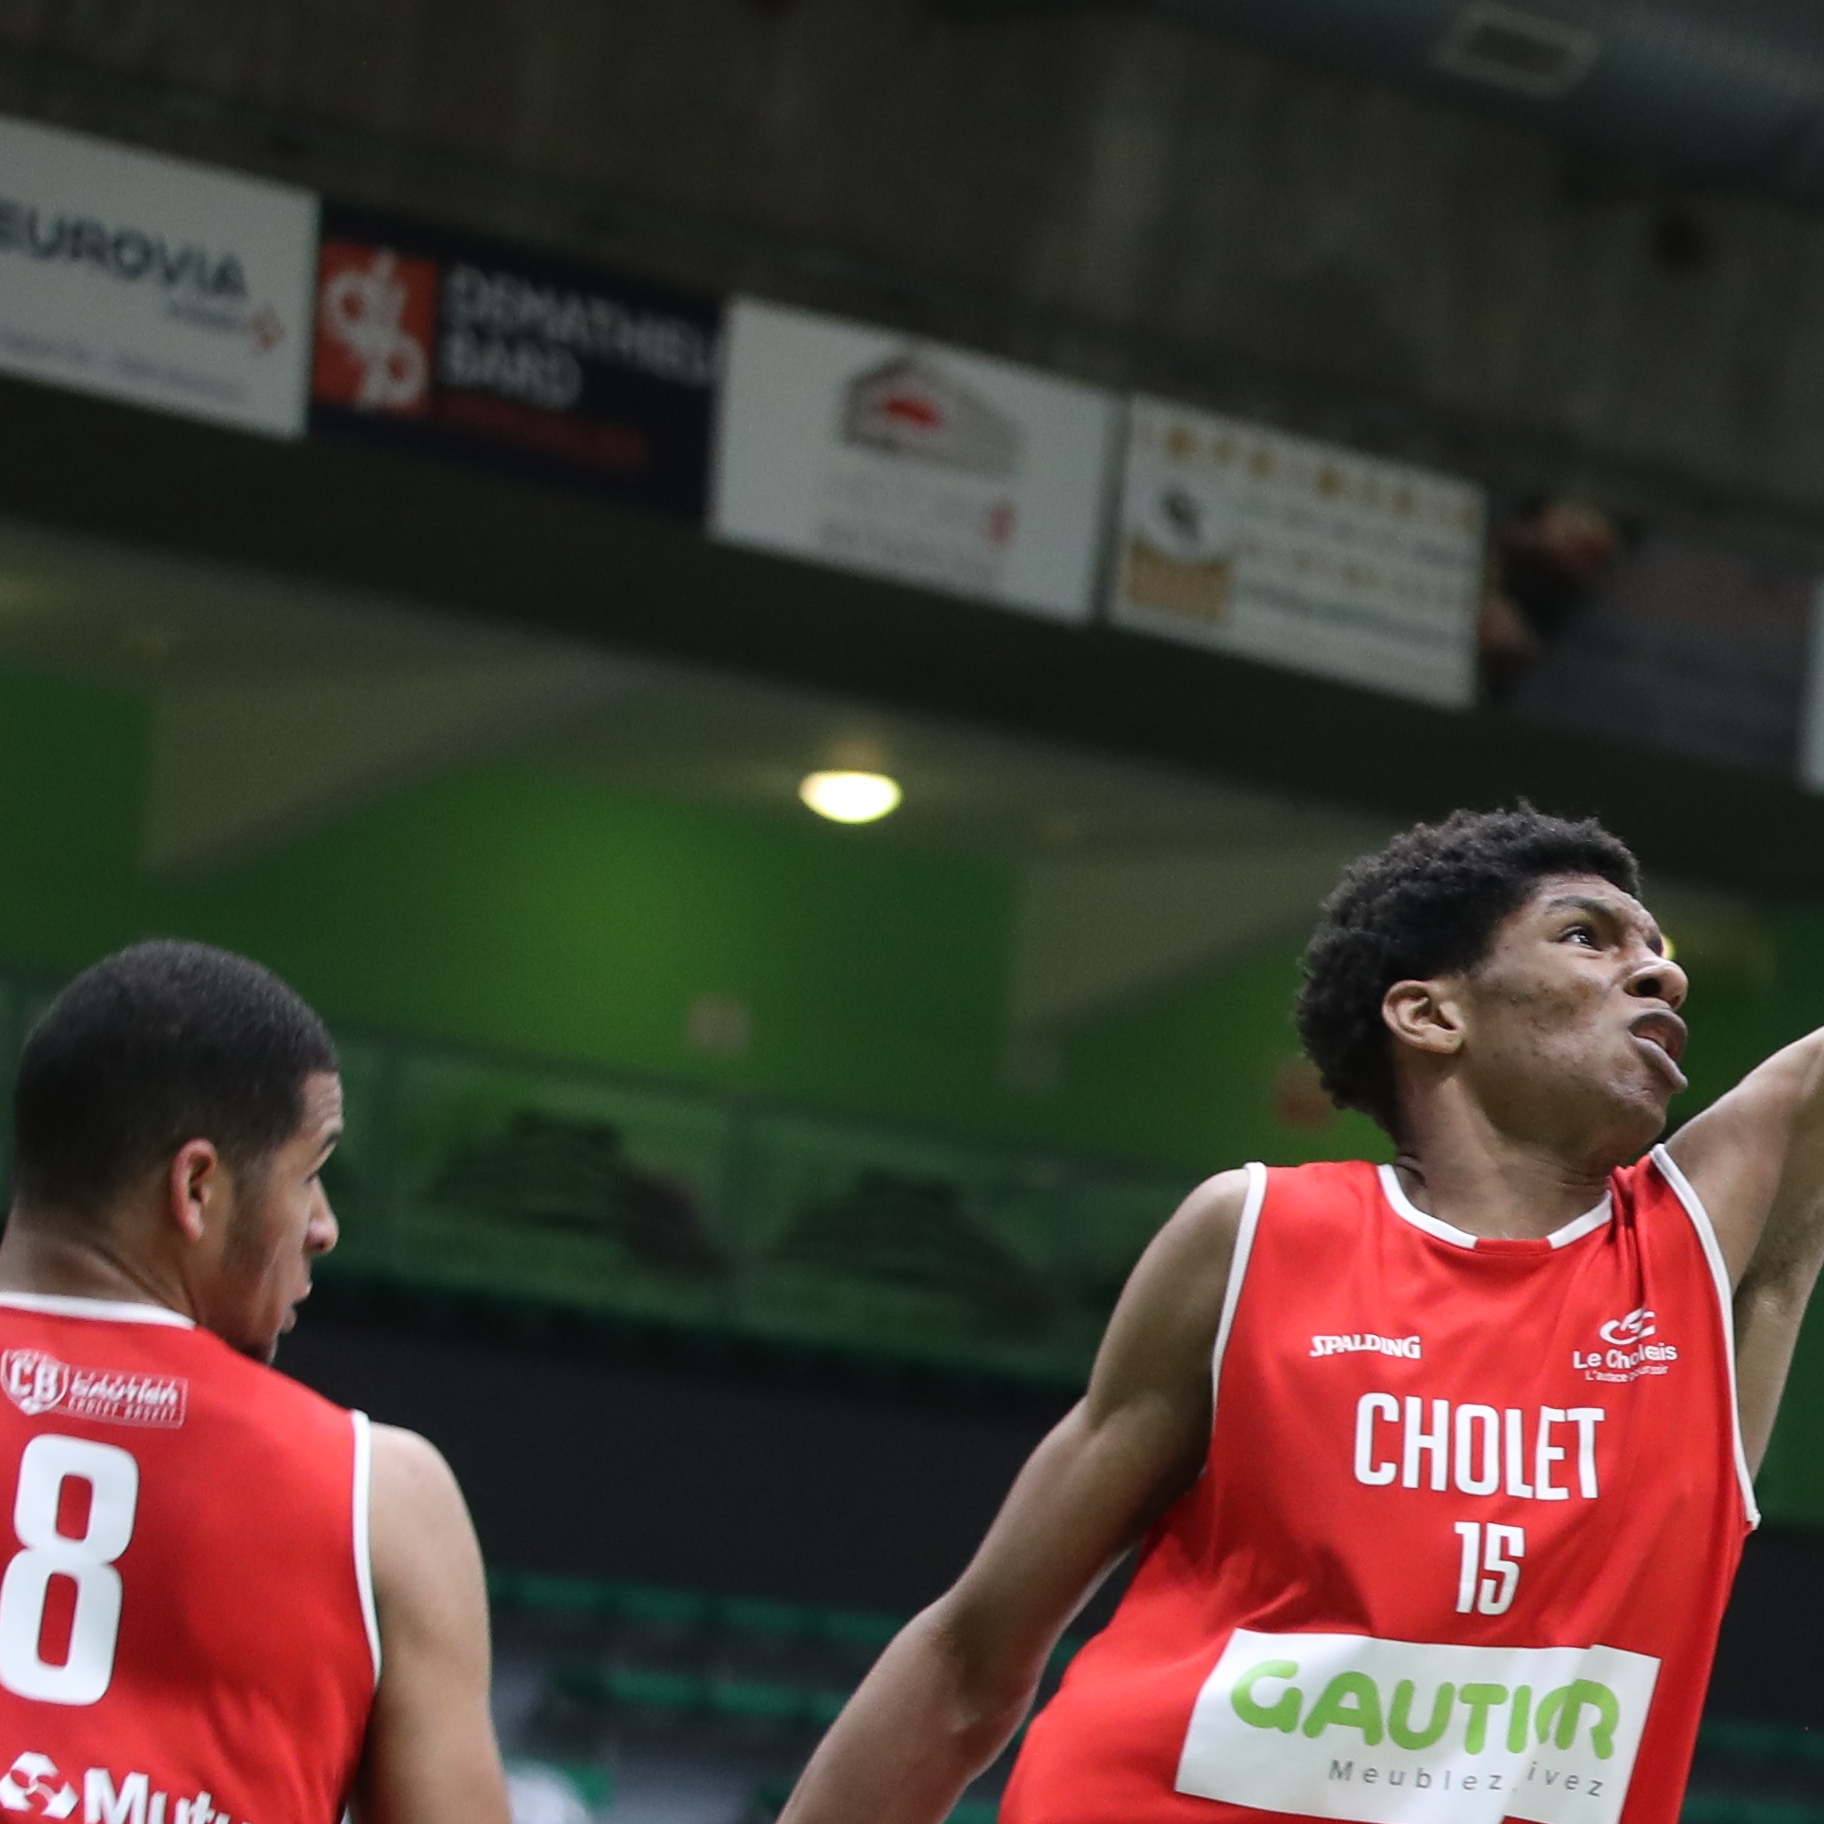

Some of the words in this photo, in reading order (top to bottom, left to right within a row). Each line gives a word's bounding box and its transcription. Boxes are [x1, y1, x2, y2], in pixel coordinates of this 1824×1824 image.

[1310, 1334, 1421, 1360] SPALDING
[1573, 1351, 1602, 1369] Le
[1353, 1391, 1605, 1500] CHOLET
[0, 1433, 139, 1706] 8
[1452, 1520, 1526, 1615] 15
[1527, 1760, 1604, 1796] ivez
